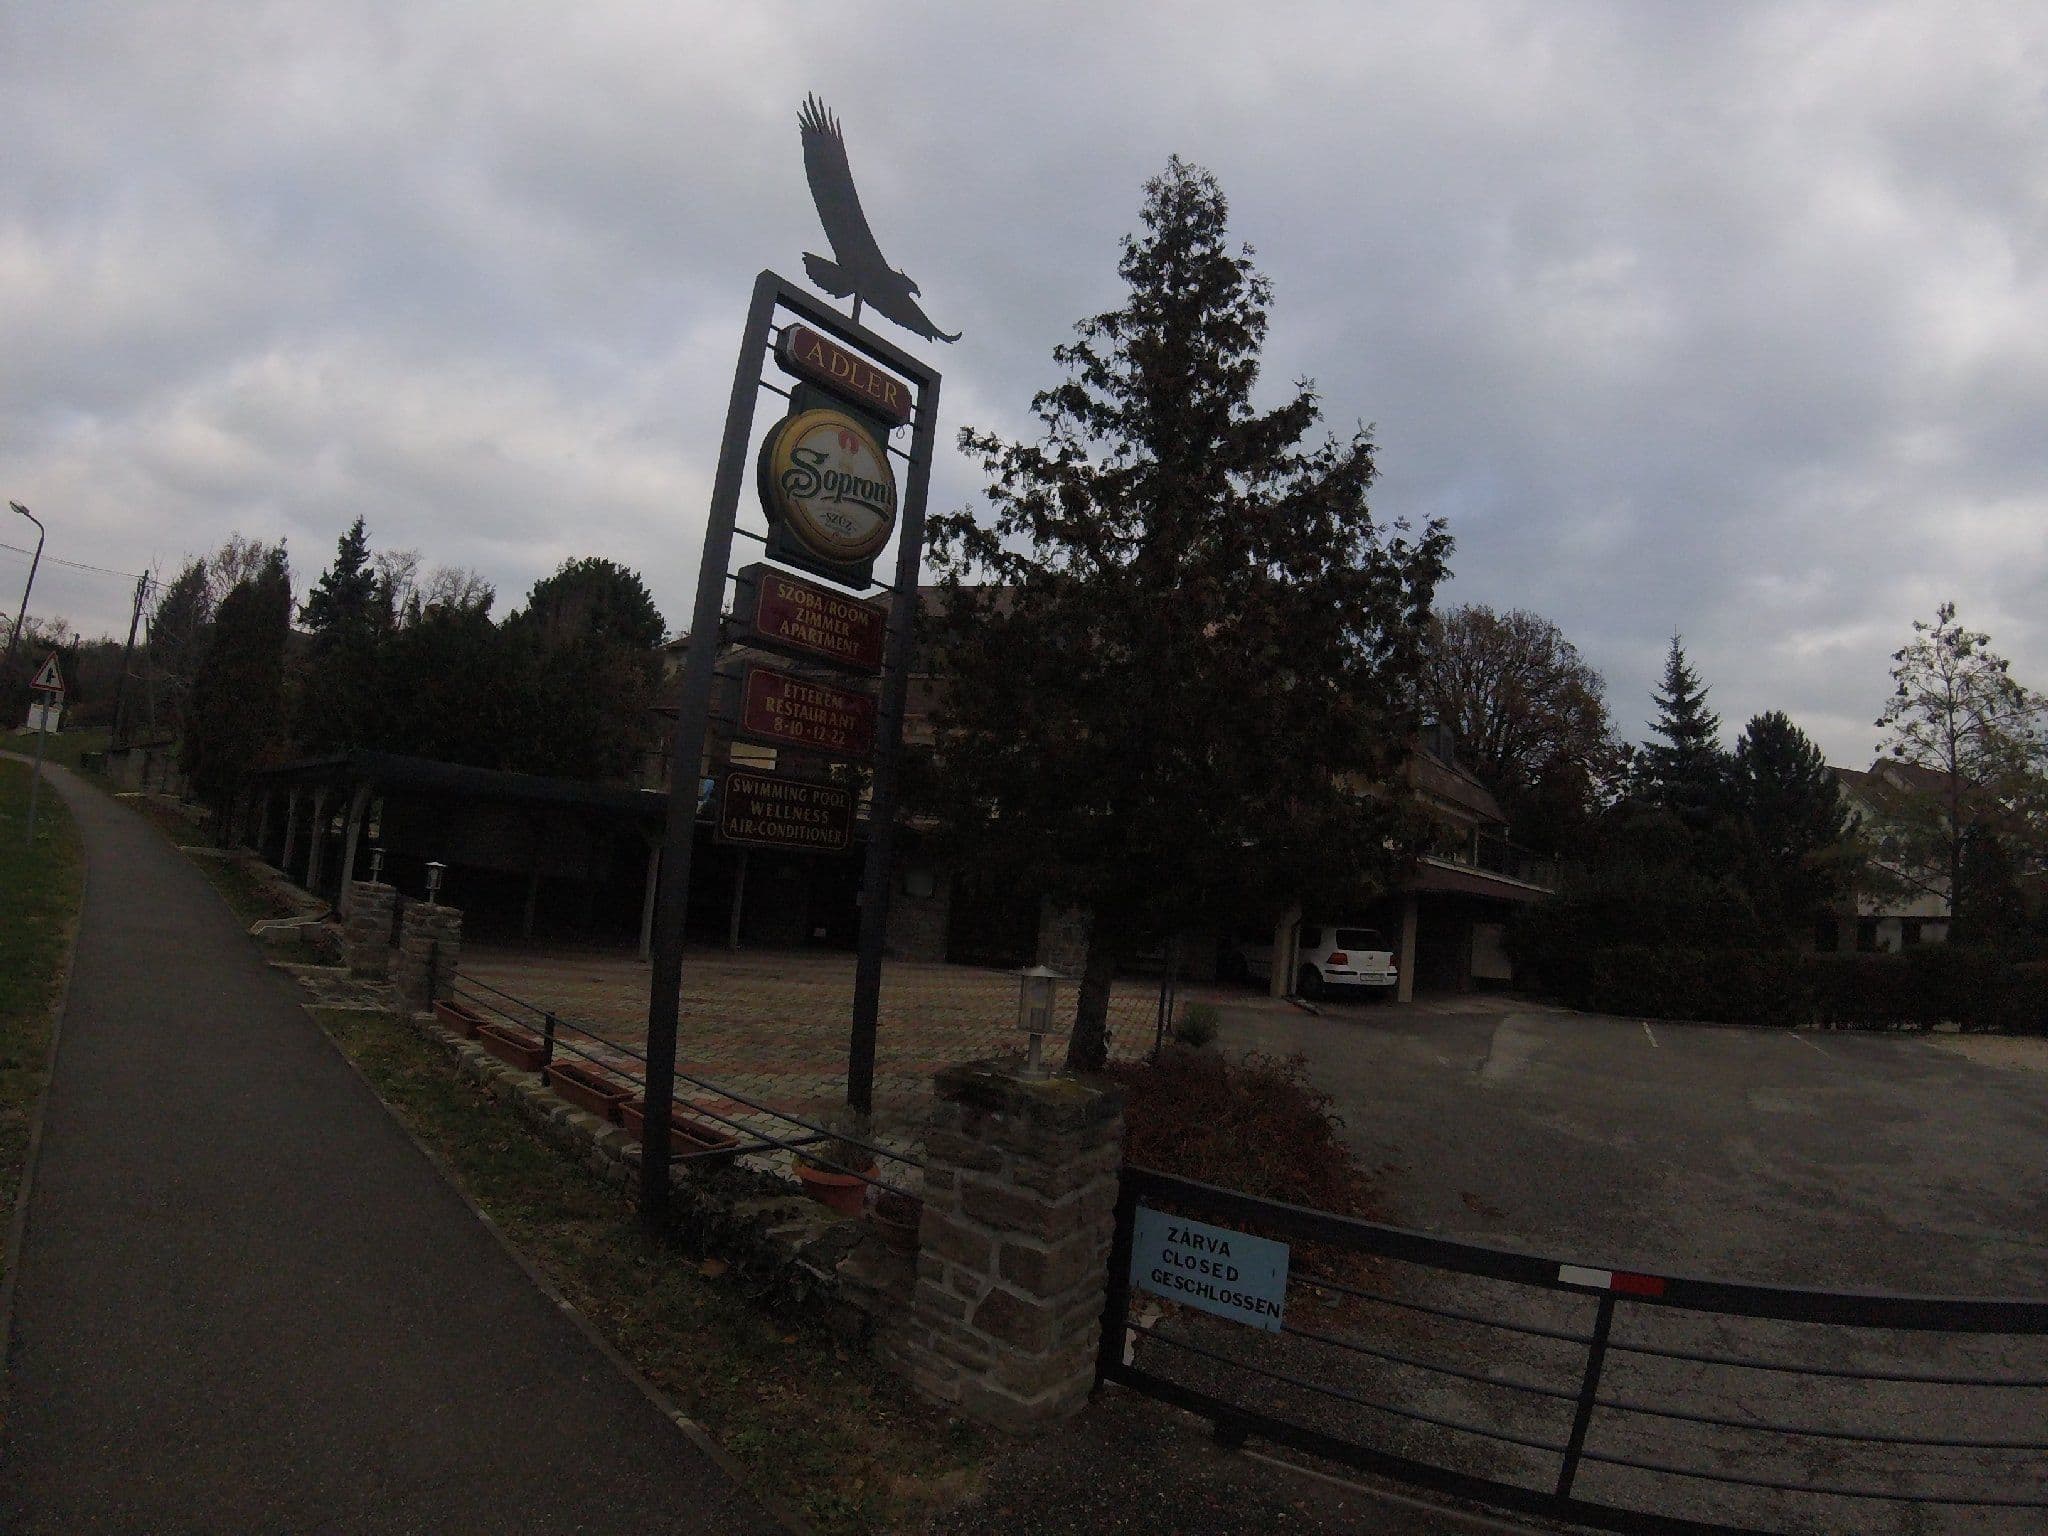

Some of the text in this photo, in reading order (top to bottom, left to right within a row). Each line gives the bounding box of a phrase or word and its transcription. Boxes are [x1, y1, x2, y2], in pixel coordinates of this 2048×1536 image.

[807, 341, 898, 408] ADLER
[779, 619, 860, 656] APARTMENT
[796, 608, 851, 636] ZIMMER
[766, 697, 857, 730] RESTAURANT
[733, 778, 846, 808] SWIMMING POOL
[750, 800, 830, 825] WELLNESS
[729, 817, 842, 844] AIR-CONDITIONER
[1168, 1227, 1231, 1258] ZÁRVA
[1163, 1249, 1239, 1282] CLOSED
[1151, 1268, 1280, 1318] GESCHLOSSEN
